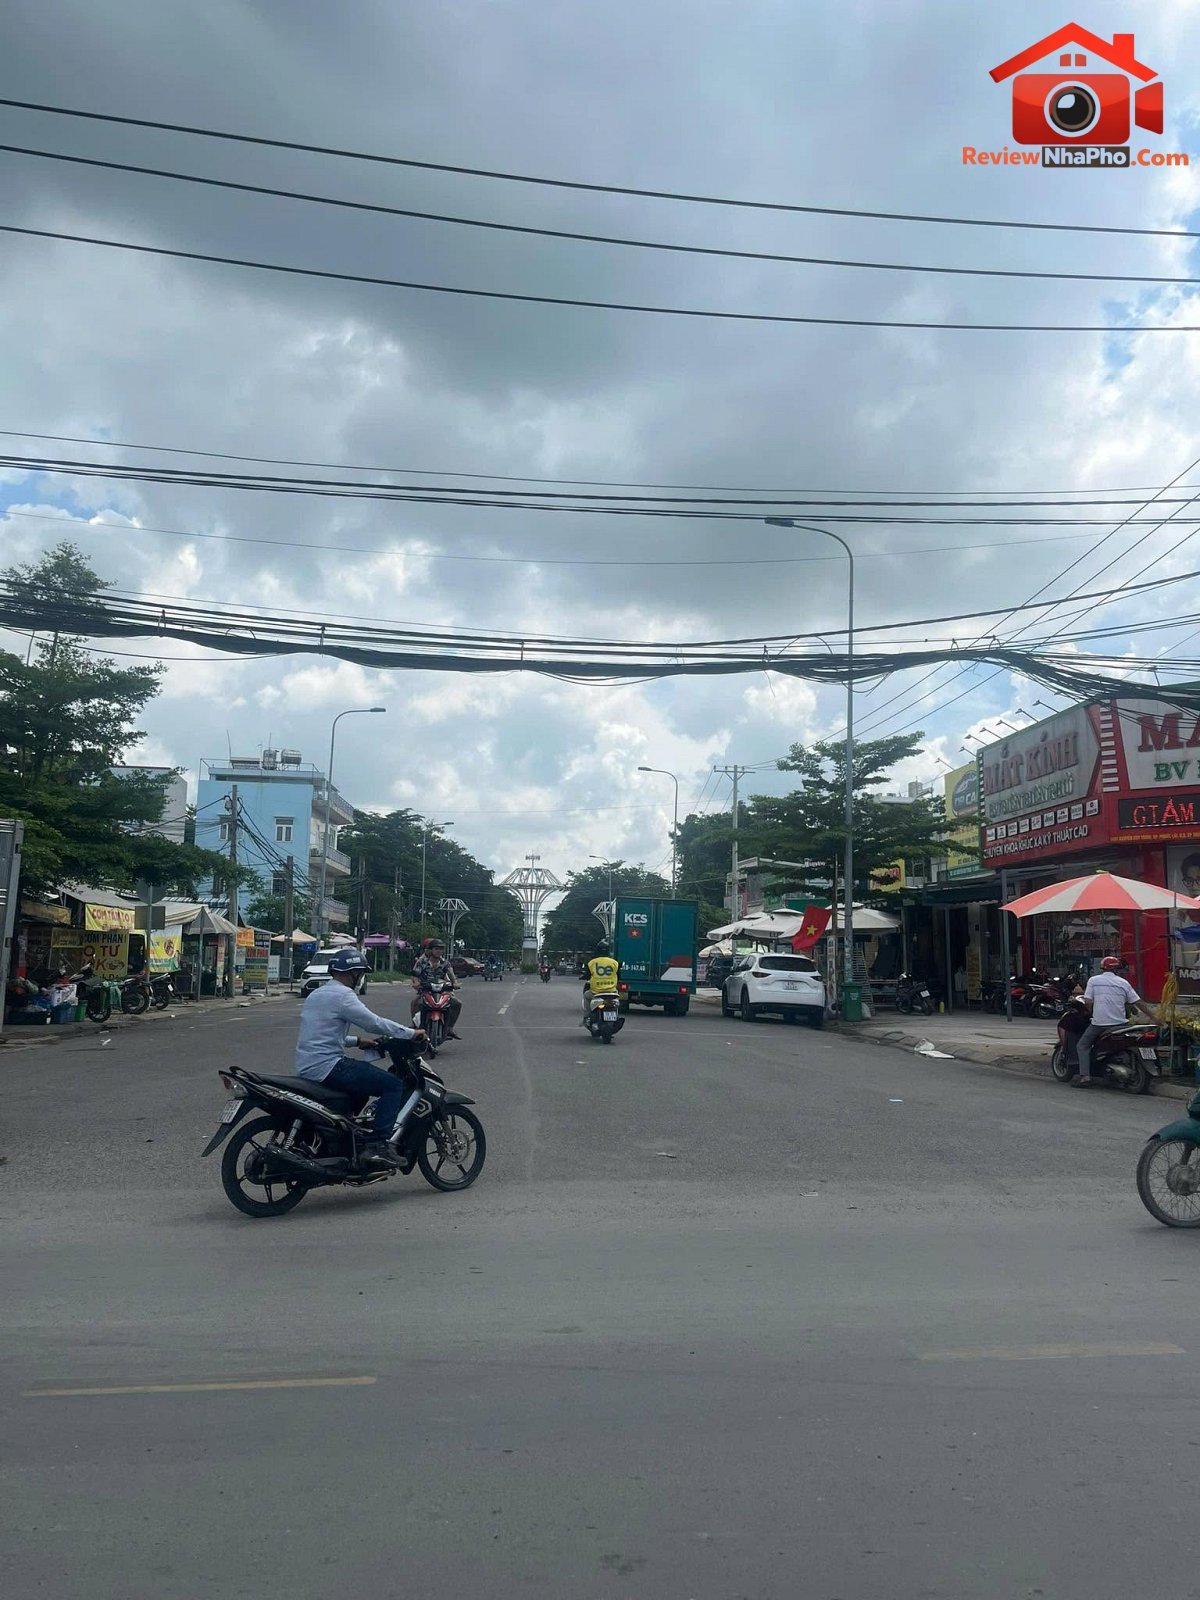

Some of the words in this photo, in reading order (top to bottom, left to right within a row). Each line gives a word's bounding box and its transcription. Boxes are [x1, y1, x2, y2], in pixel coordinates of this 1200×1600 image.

[1025, 730, 1078, 781] KÍNH
[1153, 760, 1191, 782] BV
[1004, 841, 1019, 855] KHOA
[1018, 836, 1034, 851] KHÚC
[1053, 827, 1074, 844] THUẬT
[1073, 824, 1088, 838] CAO
[595, 962, 612, 977] be
